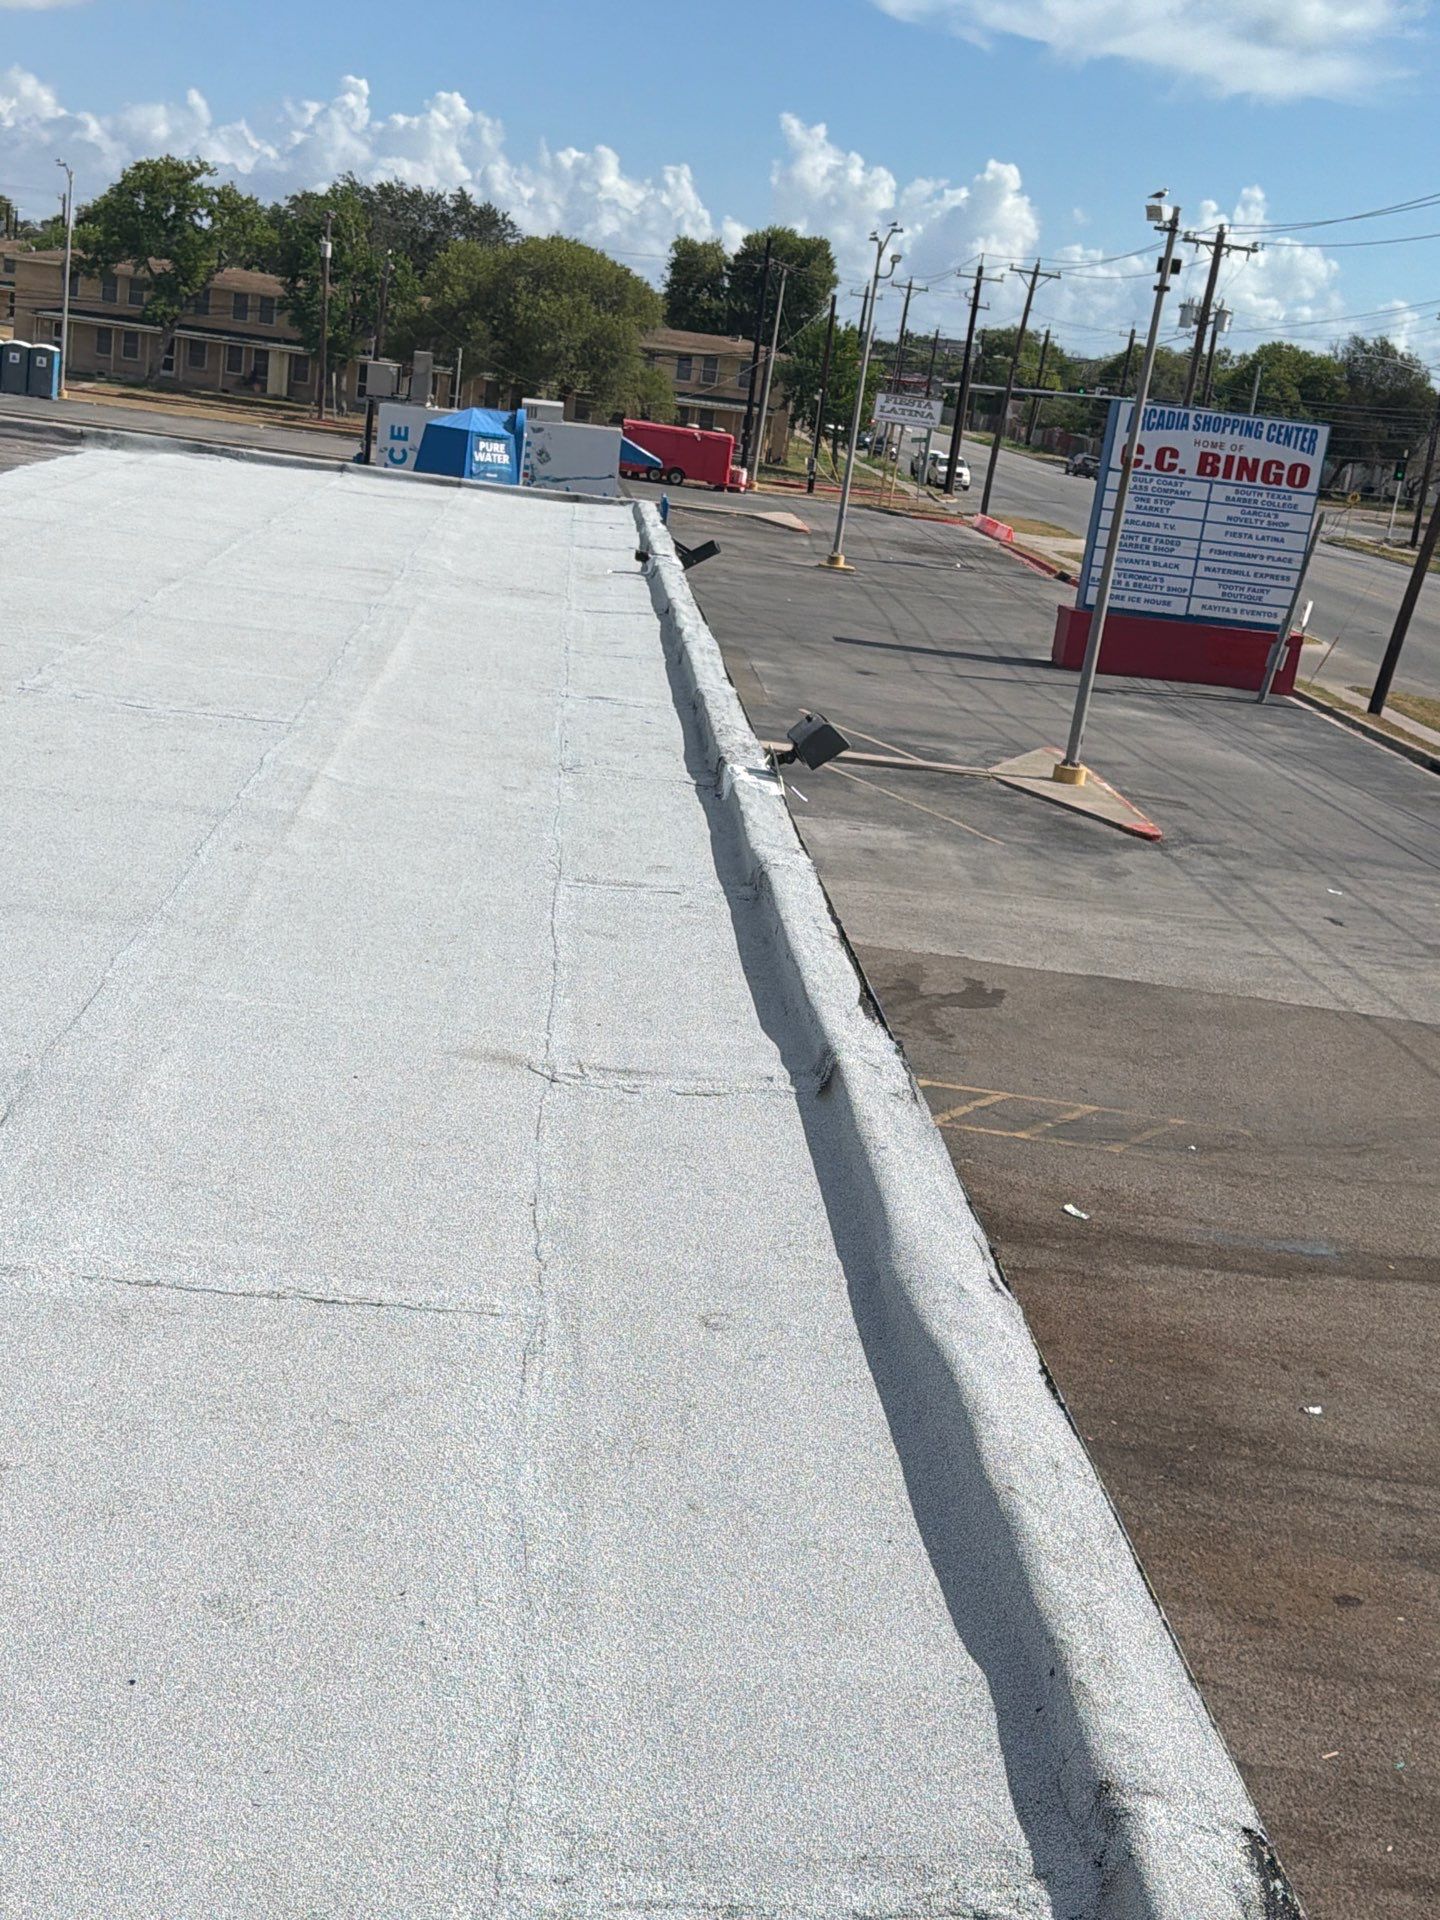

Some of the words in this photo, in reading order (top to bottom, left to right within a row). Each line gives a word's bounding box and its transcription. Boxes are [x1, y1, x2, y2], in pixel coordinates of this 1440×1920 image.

[884, 394, 934, 409] FIESTA
[879, 404, 936, 420] LATINA
[1192, 413, 1264, 441] SHOPPING
[1265, 420, 1319, 457] CENTER
[479, 441, 506, 454] PURE
[1193, 438, 1226, 452] HOME
[1229, 443, 1245, 453] OF
[473, 451, 510, 465] WATER
[1196, 451, 1311, 489] BINGO
[1131, 475, 1154, 484] GULF
[1156, 479, 1185, 488] COAST
[1151, 486, 1192, 497] COMPANY
[1234, 488, 1264, 499] SOUTH
[1265, 492, 1292, 501] TEXAS
[1133, 496, 1152, 505] ONE
[1154, 498, 1176, 507] STOP
[1225, 495, 1259, 506] BARBER
[1261, 499, 1299, 510] COLLEGE
[1135, 504, 1171, 515] MARKET
[1240, 508, 1280, 520] GARCIA'S
[1123, 519, 1160, 529] ARCADIA
[1226, 514, 1265, 526] NOVELTY
[1266, 520, 1290, 529] SHOP
[1141, 536, 1154, 544] BE
[1155, 537, 1182, 547] FADED
[1224, 530, 1253, 541] FIESTA
[1255, 534, 1286, 545] LATINA
[1153, 545, 1176, 553] SHOP
[1266, 555, 1293, 564] PLACE
[1116, 571, 1165, 584] VERONICA'S
[1203, 565, 1251, 578] WATERMILL
[1253, 571, 1291, 582] EXPRESS
[1132, 582, 1165, 593] BEAUTY
[1166, 585, 1189, 594] SHOP
[1217, 583, 1245, 593] TOOTH
[1246, 587, 1271, 595] FAIRY
[1127, 596, 1142, 604] ICE
[1142, 599, 1173, 608] HOUSE
[1221, 591, 1264, 602] BOUTIQUE
[1240, 608, 1279, 619] EVENTOS
